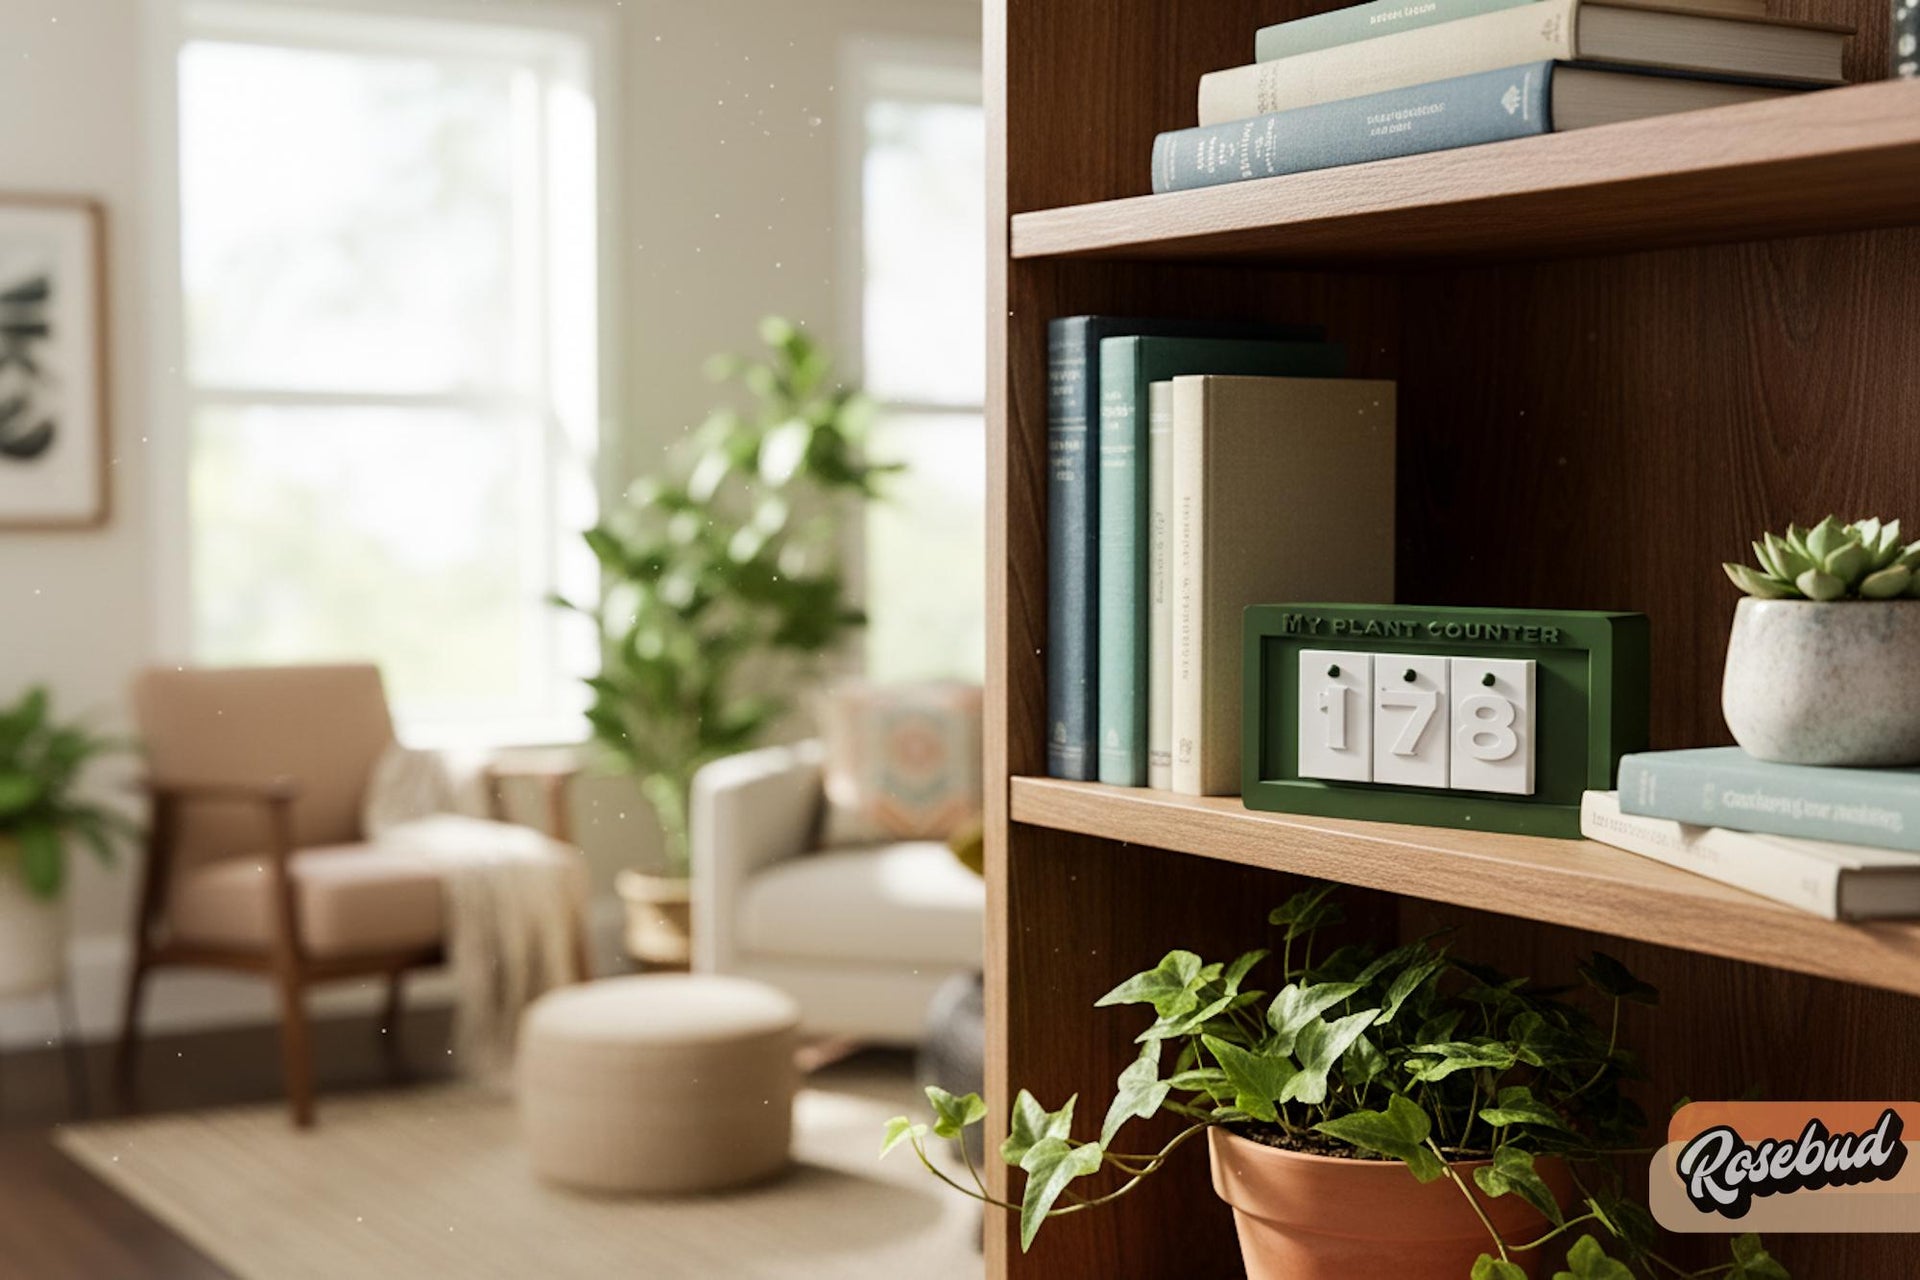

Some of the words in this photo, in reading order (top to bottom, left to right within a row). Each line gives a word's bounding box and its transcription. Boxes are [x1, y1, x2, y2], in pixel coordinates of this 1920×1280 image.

[1282, 613, 1322, 635] MY
[1333, 618, 1418, 639] PLANT
[1427, 620, 1562, 644] COUNTER
